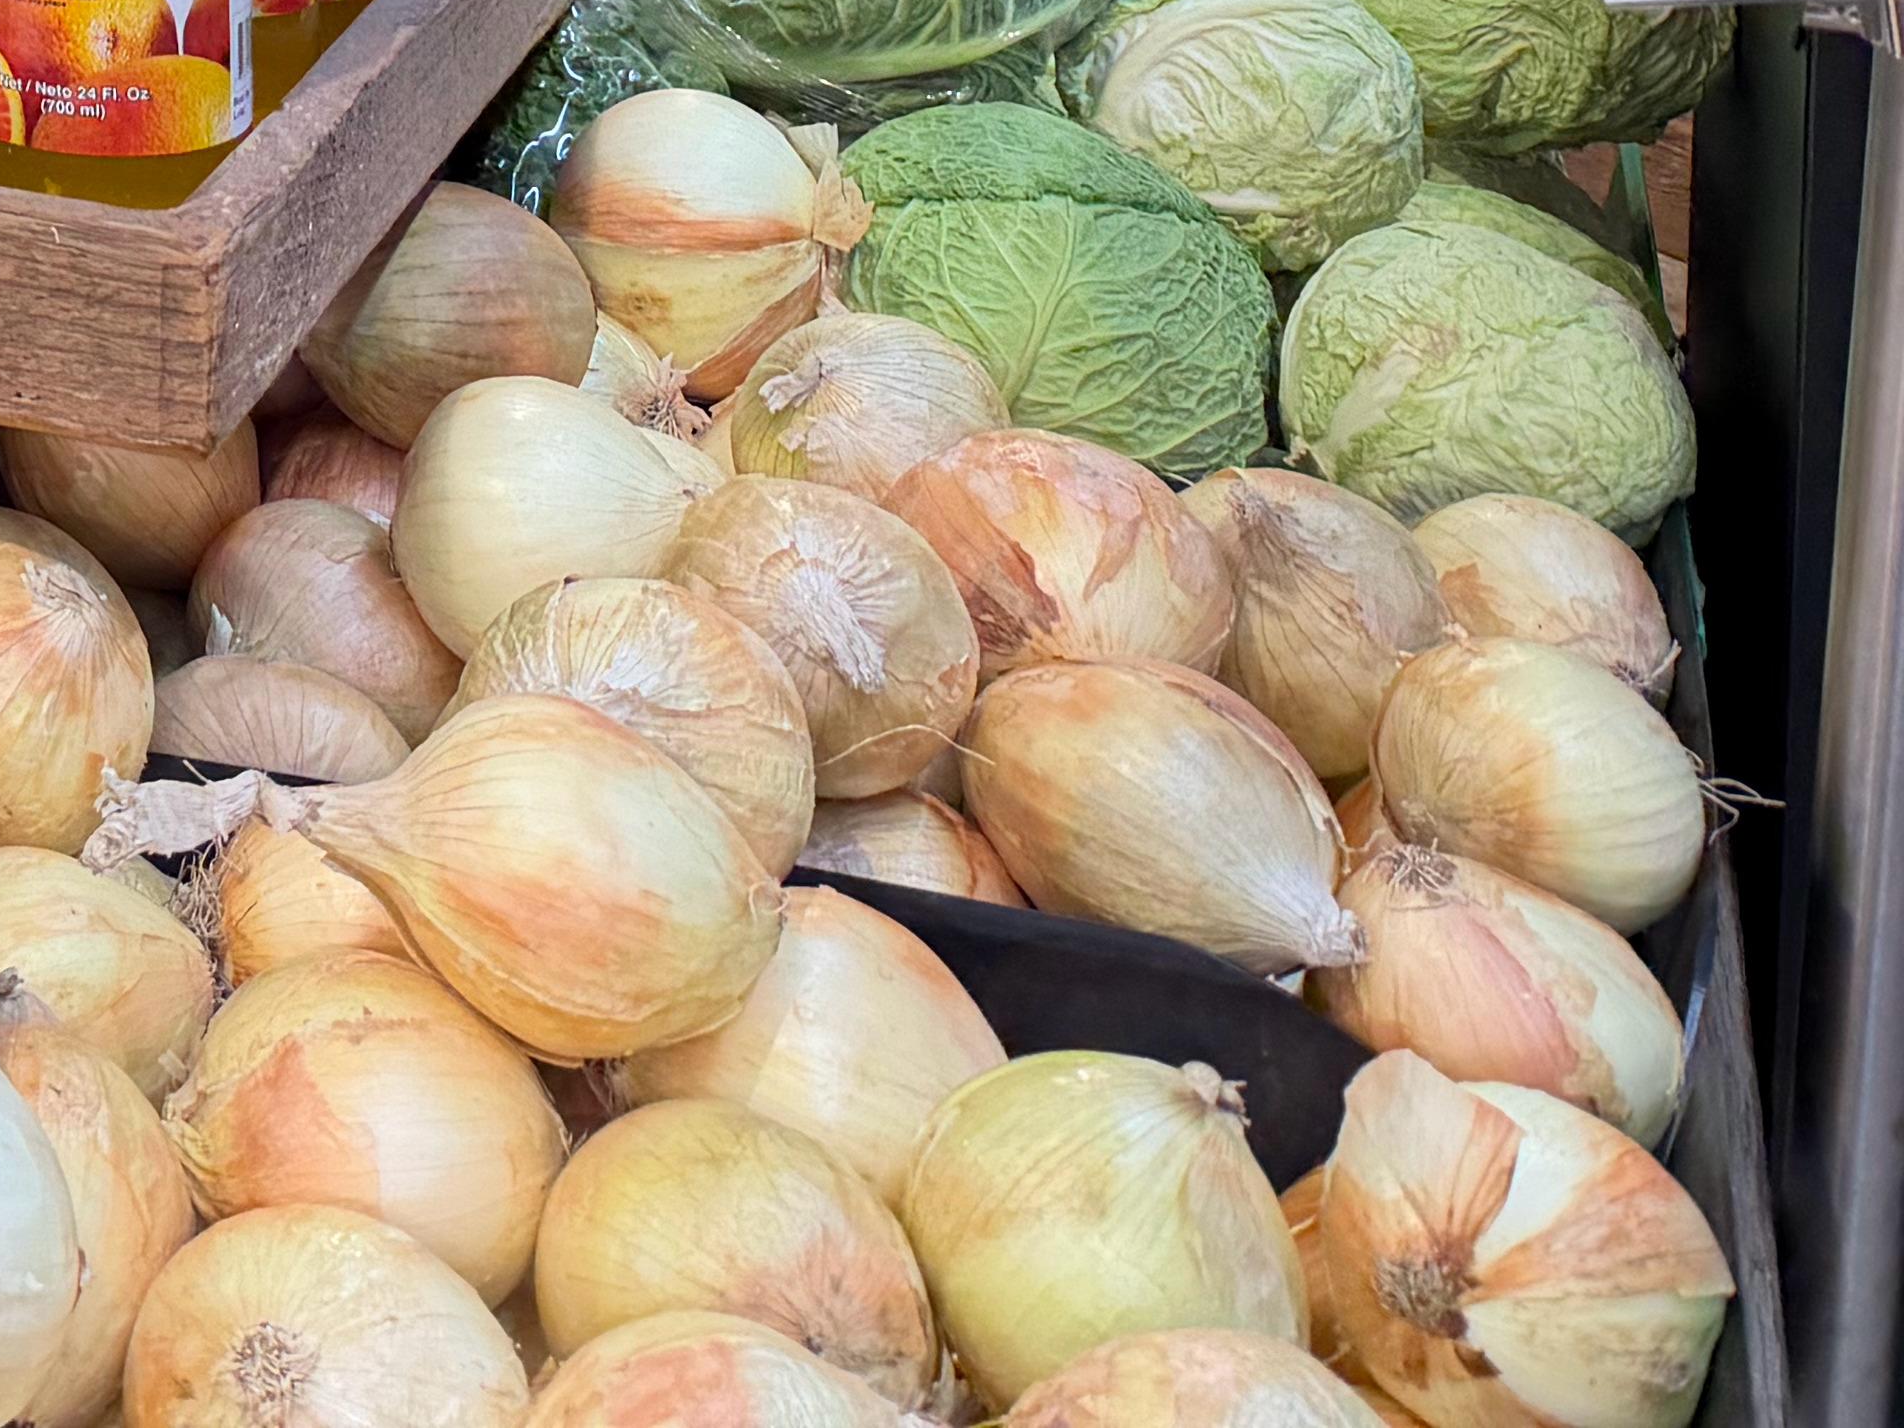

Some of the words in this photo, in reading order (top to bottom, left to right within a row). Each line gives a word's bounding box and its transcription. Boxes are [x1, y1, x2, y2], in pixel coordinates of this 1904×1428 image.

[35, 81, 73, 100] Neto
[76, 85, 97, 102] 24
[39, 97, 73, 117] (700
[78, 101, 107, 120] ml)
